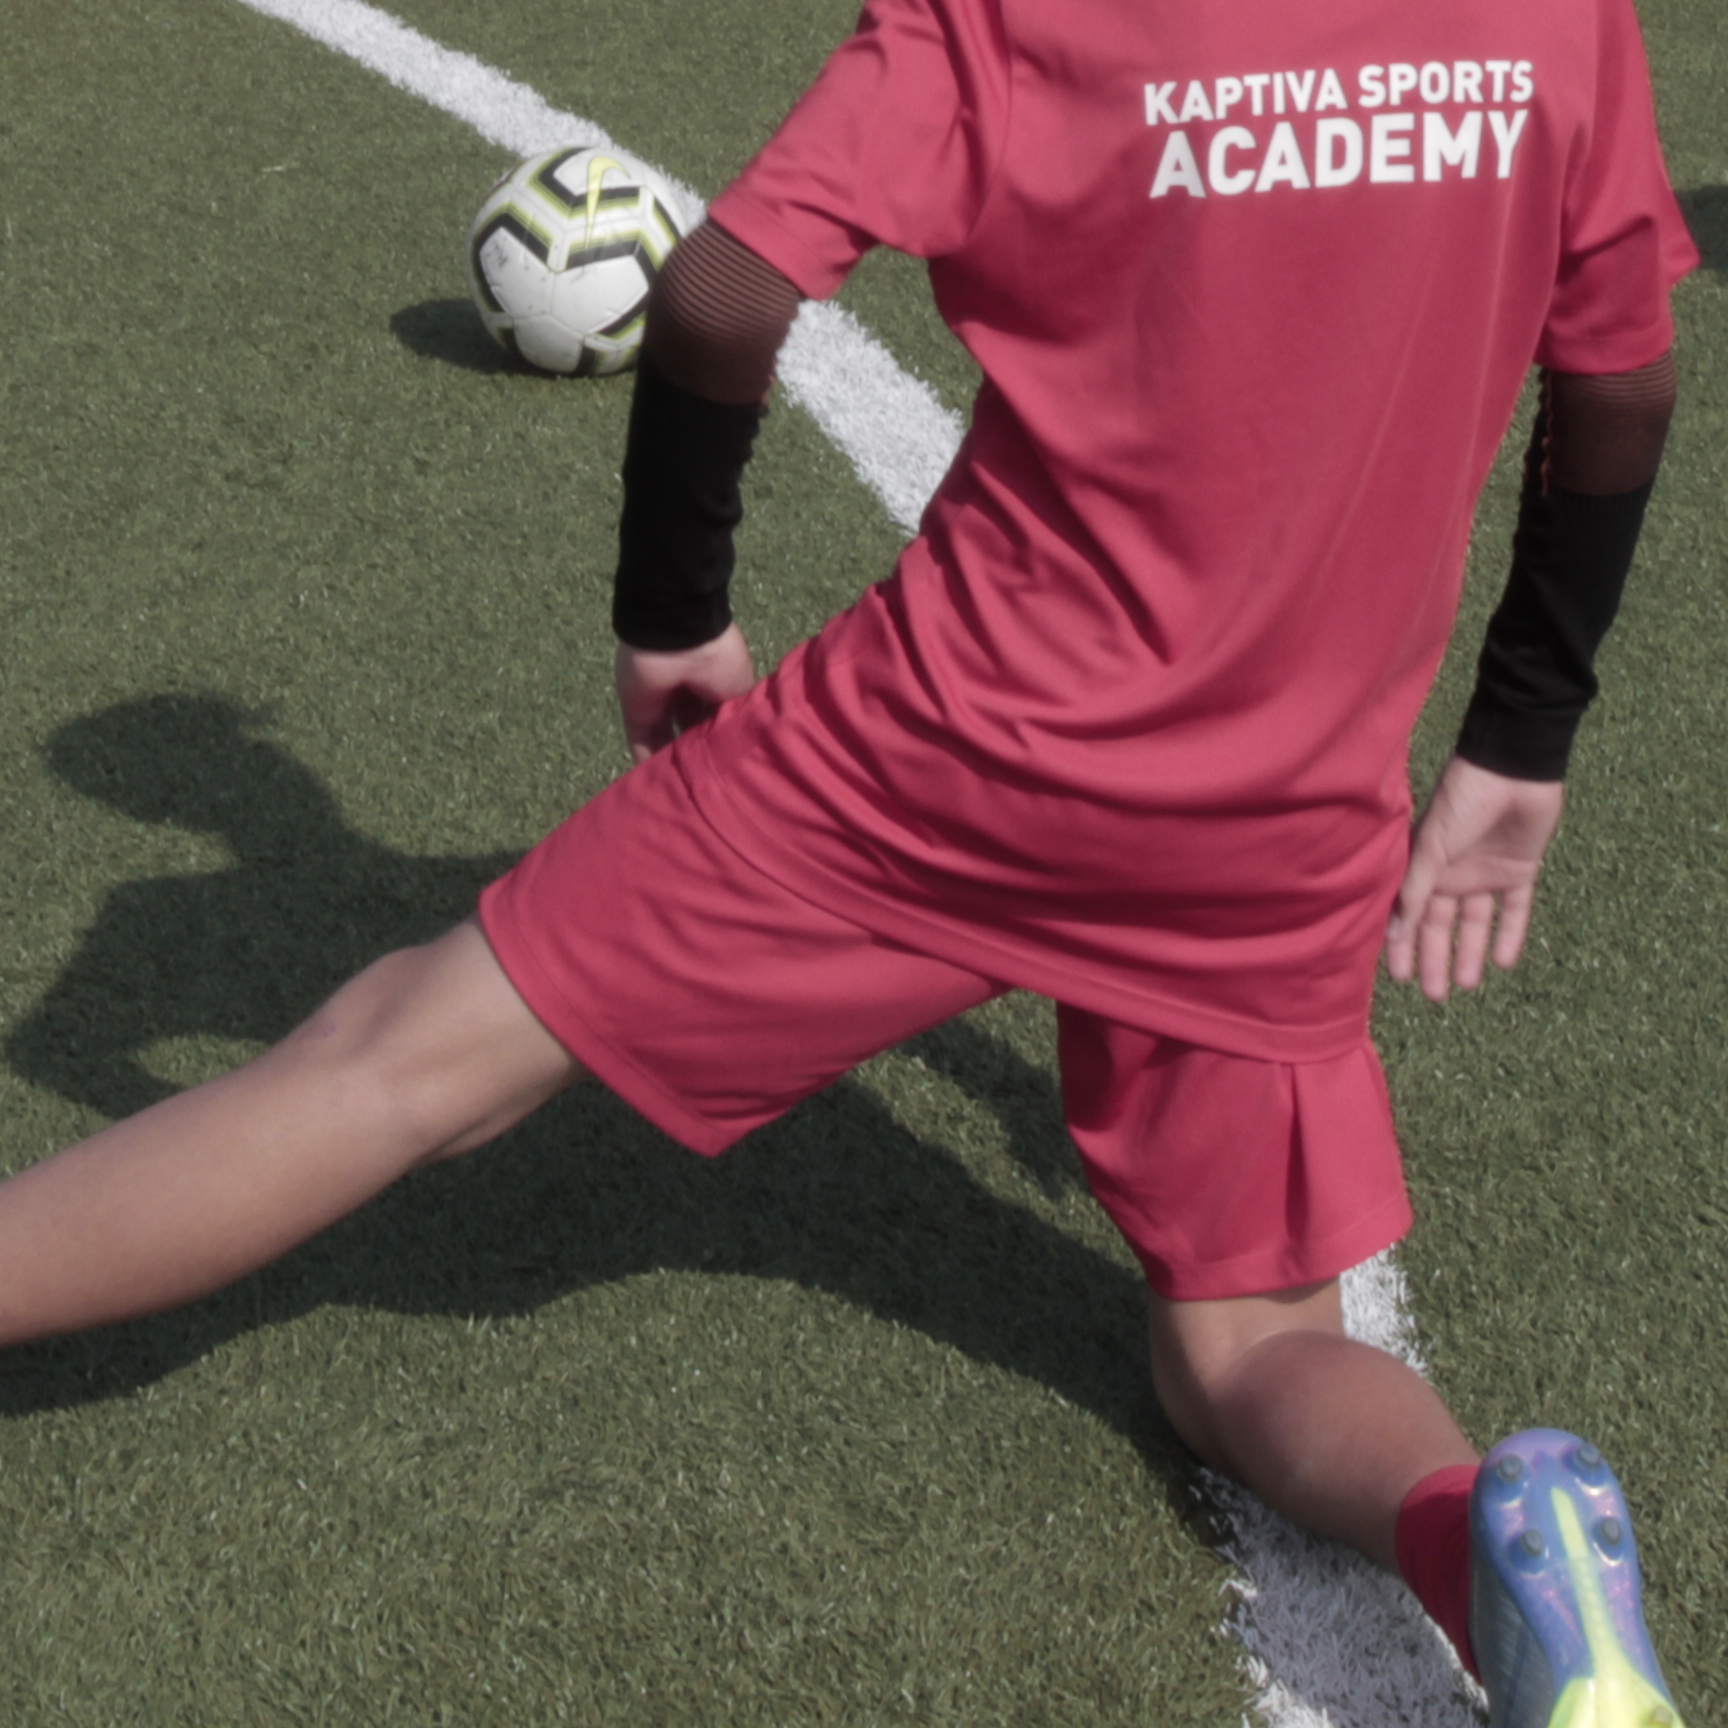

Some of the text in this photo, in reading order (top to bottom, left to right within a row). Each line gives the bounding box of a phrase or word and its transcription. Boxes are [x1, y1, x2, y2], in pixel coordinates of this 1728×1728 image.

[1144, 60, 1534, 126] KAPTIVA SPORTS
[1149, 109, 1529, 199] ACADEMY
